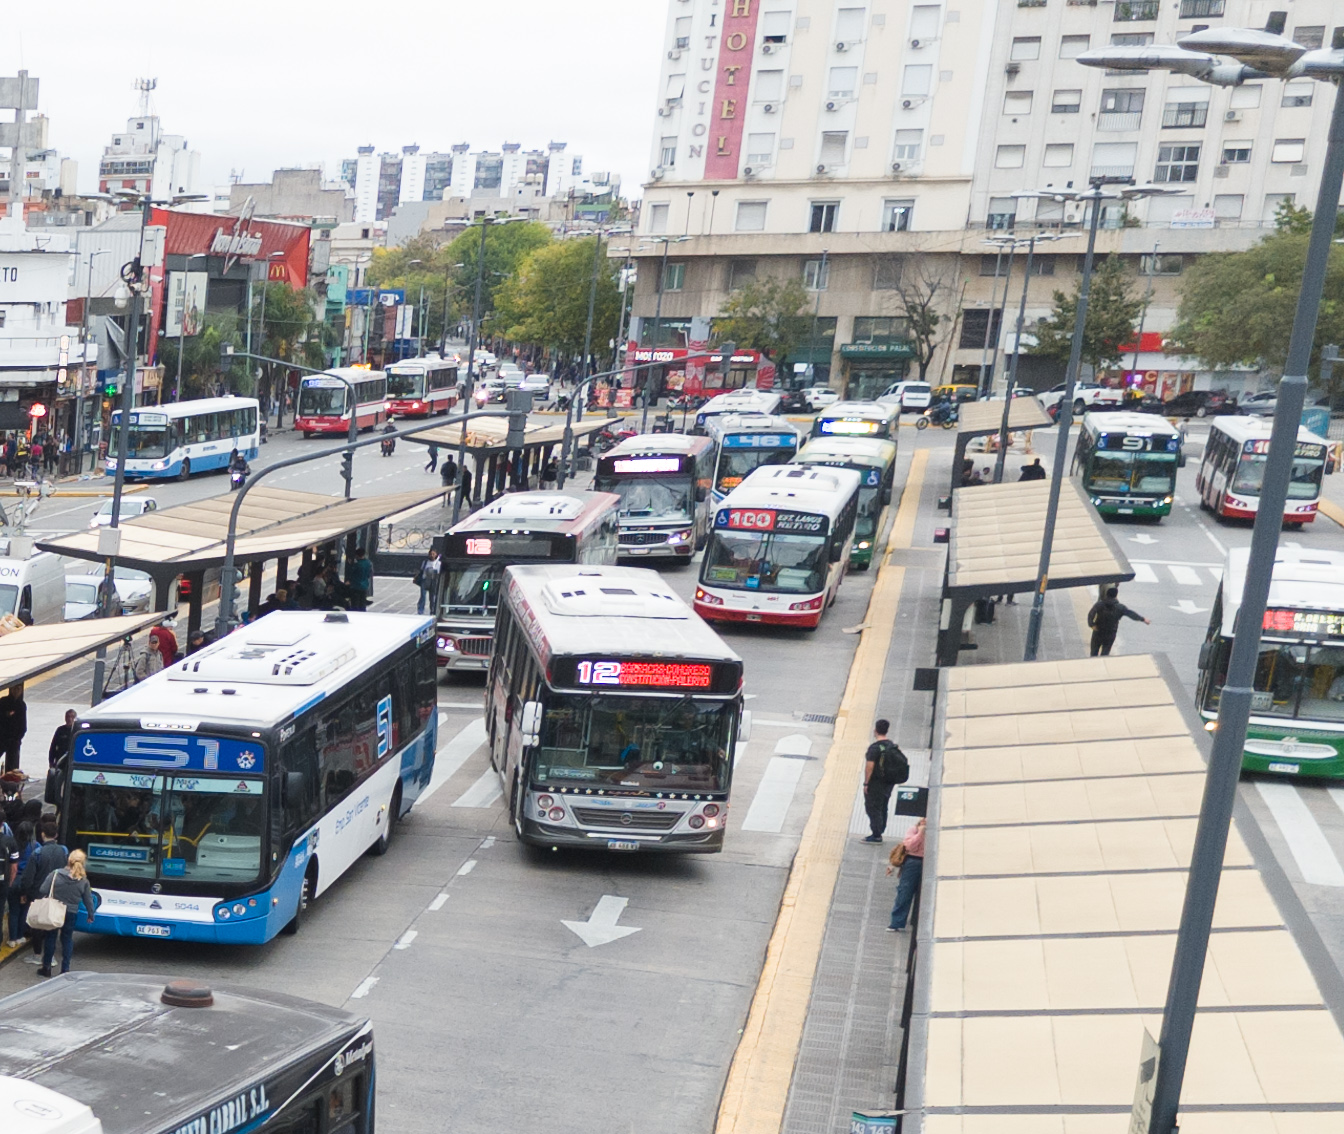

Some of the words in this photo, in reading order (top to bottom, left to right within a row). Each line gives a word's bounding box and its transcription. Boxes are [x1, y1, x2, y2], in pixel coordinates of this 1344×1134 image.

[716, 0, 750, 156] HOTEL
[739, 435, 781, 447] 46
[1121, 436, 1153, 451] 91
[729, 511, 771, 527] 100
[466, 538, 492, 555] 12
[577, 661, 621, 685] 12
[376, 694, 393, 759] 51
[122, 735, 220, 770] 51
[95, 849, 143, 859] CAÑUELAS
